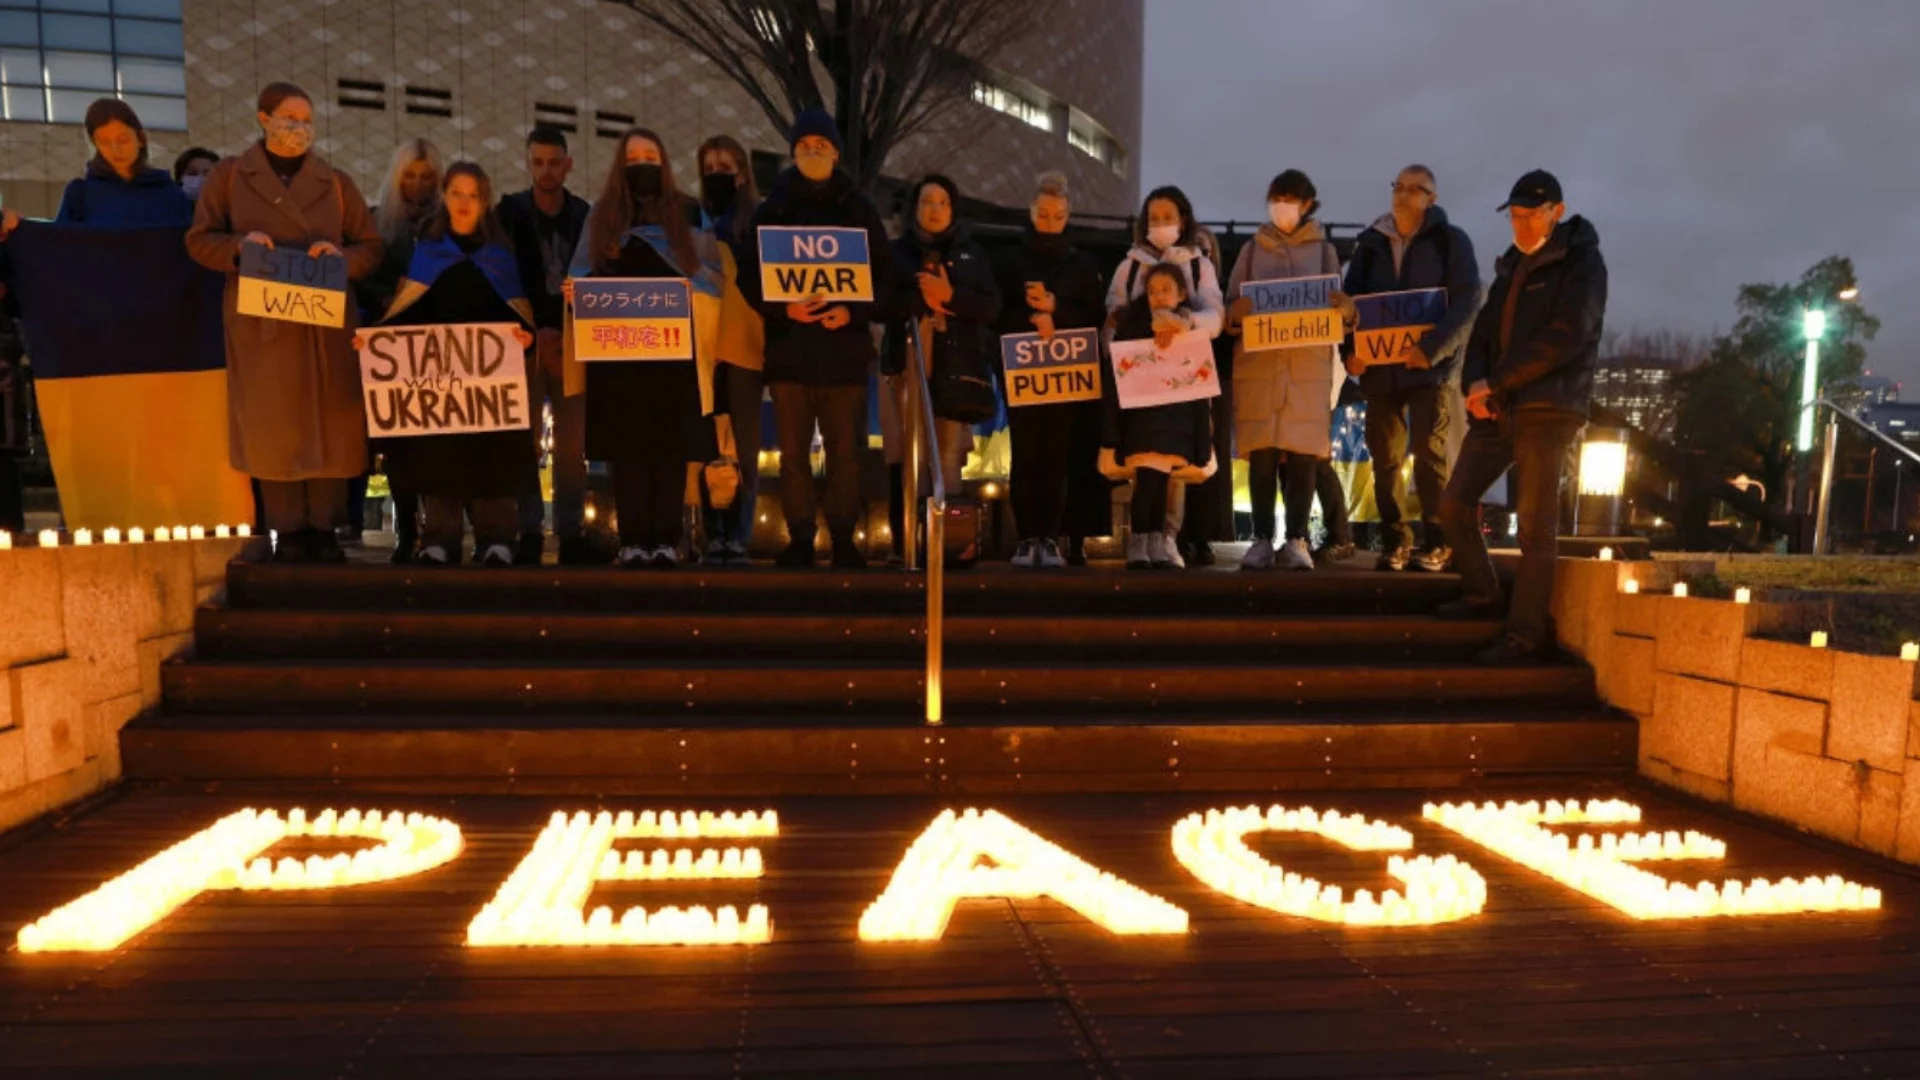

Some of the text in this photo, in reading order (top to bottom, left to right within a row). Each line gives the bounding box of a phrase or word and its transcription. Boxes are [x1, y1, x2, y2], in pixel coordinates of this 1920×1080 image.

[793, 234, 839, 258] NO
[258, 250, 341, 283] STOP
[776, 267, 857, 293] WAR
[263, 287, 335, 319] WAR
[582, 291, 679, 308] ウクライナに
[1380, 296, 1424, 324] NO
[1294, 315, 1329, 339] child
[368, 328, 505, 381] STAND
[1016, 337, 1088, 363] STOP
[1366, 331, 1420, 359] WA
[404, 370, 463, 390] with
[1014, 370, 1093, 397] PUTIN
[369, 383, 522, 429] UKRAINE
[17, 797, 1882, 952] PEACE
